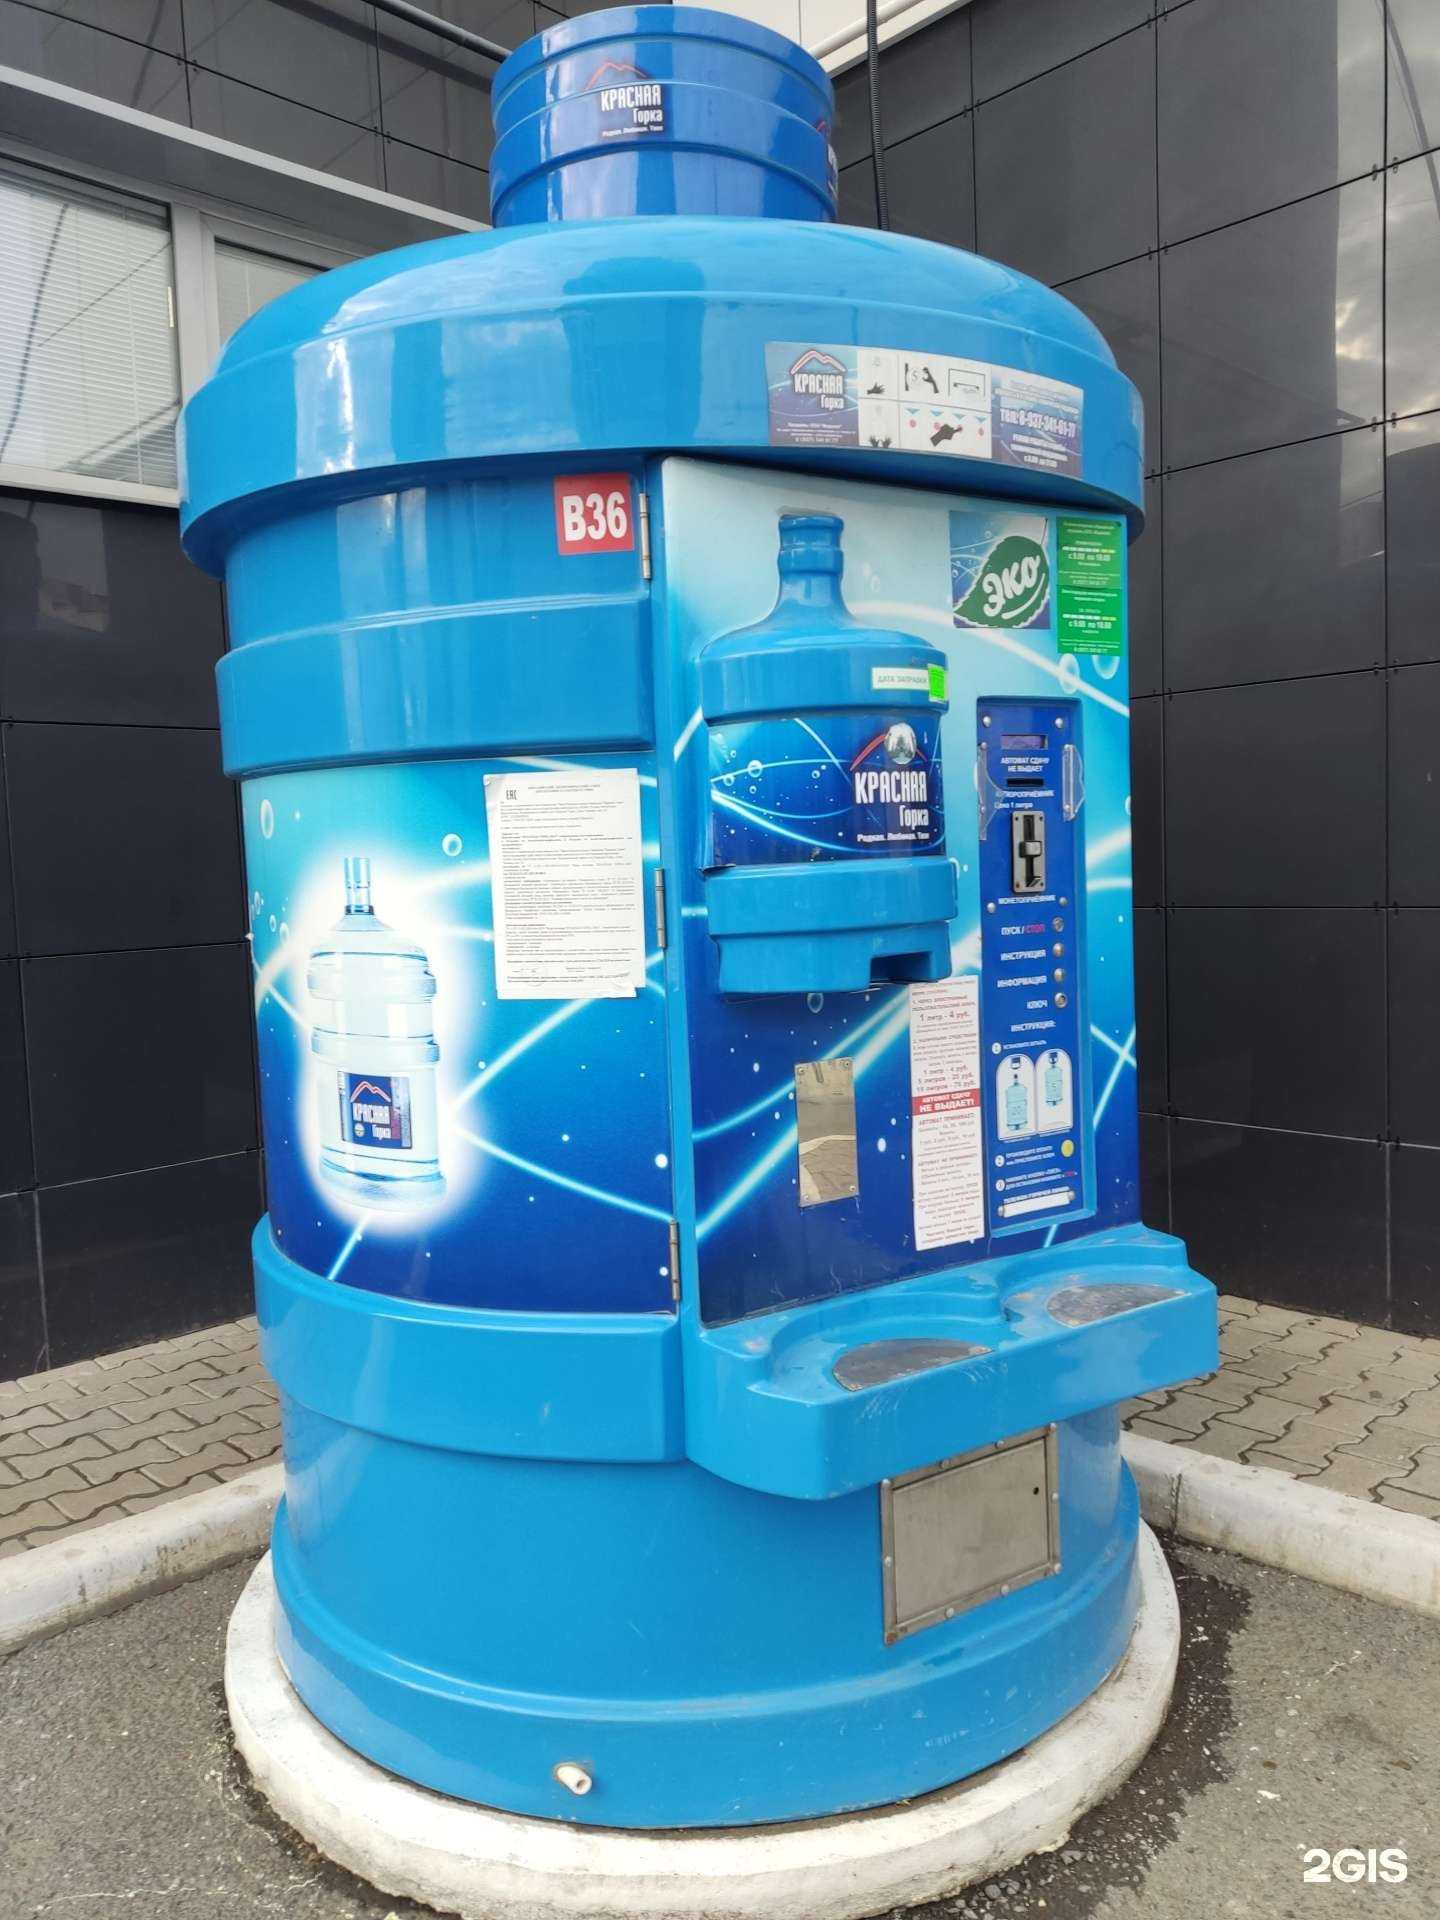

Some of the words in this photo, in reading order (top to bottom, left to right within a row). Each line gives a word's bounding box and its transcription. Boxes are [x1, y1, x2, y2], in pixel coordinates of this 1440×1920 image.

[601, 85, 661, 112] КРАСНАЯ
[633, 108, 663, 125] Горка
[794, 373, 843, 395] КРАСНАЯ
[821, 395, 845, 411] Горка
[983, 555, 1041, 617] ЭКО
[855, 771, 927, 804] КРАСНАЯ
[899, 804, 929, 830] Горка
[997, 975, 1047, 988] ИНФОРМАЦИЯ
